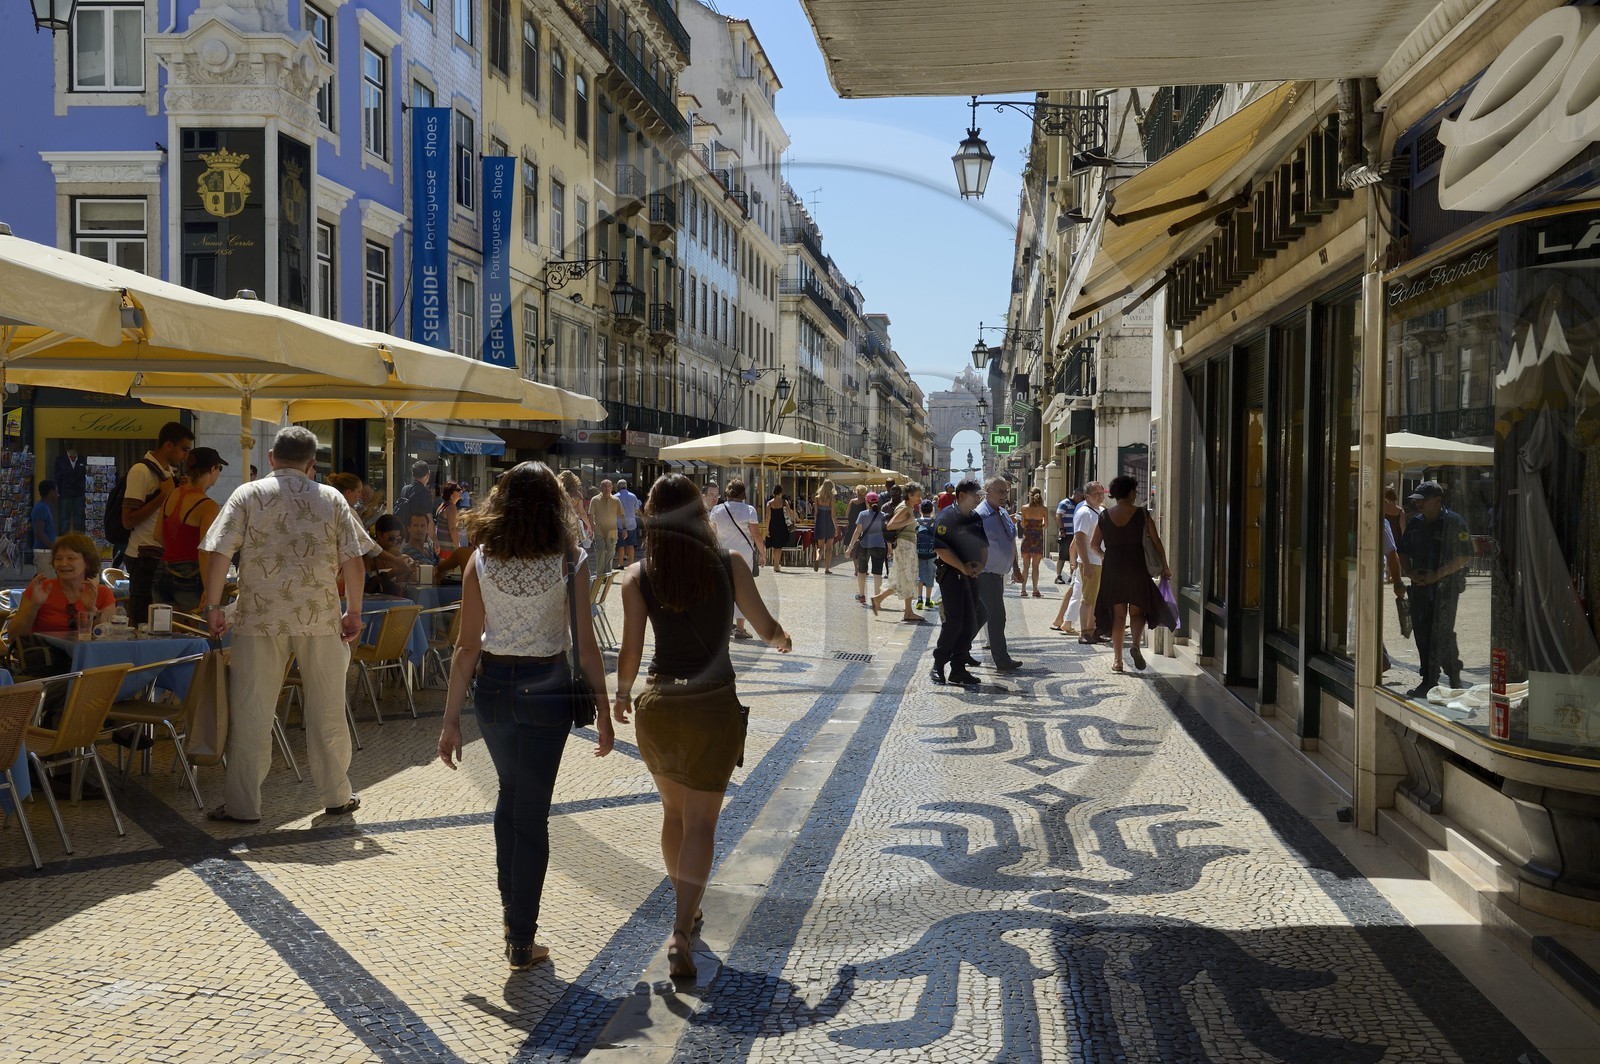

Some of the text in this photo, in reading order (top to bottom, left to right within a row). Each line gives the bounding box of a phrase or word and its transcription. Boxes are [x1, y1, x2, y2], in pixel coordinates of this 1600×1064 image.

[192, 233, 223, 247] Nunes
[423, 115, 440, 343] SEASIDE Portuguese shoes
[490, 163, 506, 360] SEASIDE Portuguese shoes
[1388, 248, 1494, 307] Casa Frazão
[71, 411, 143, 433] Saldos
[463, 441, 483, 455] SEASIDE
